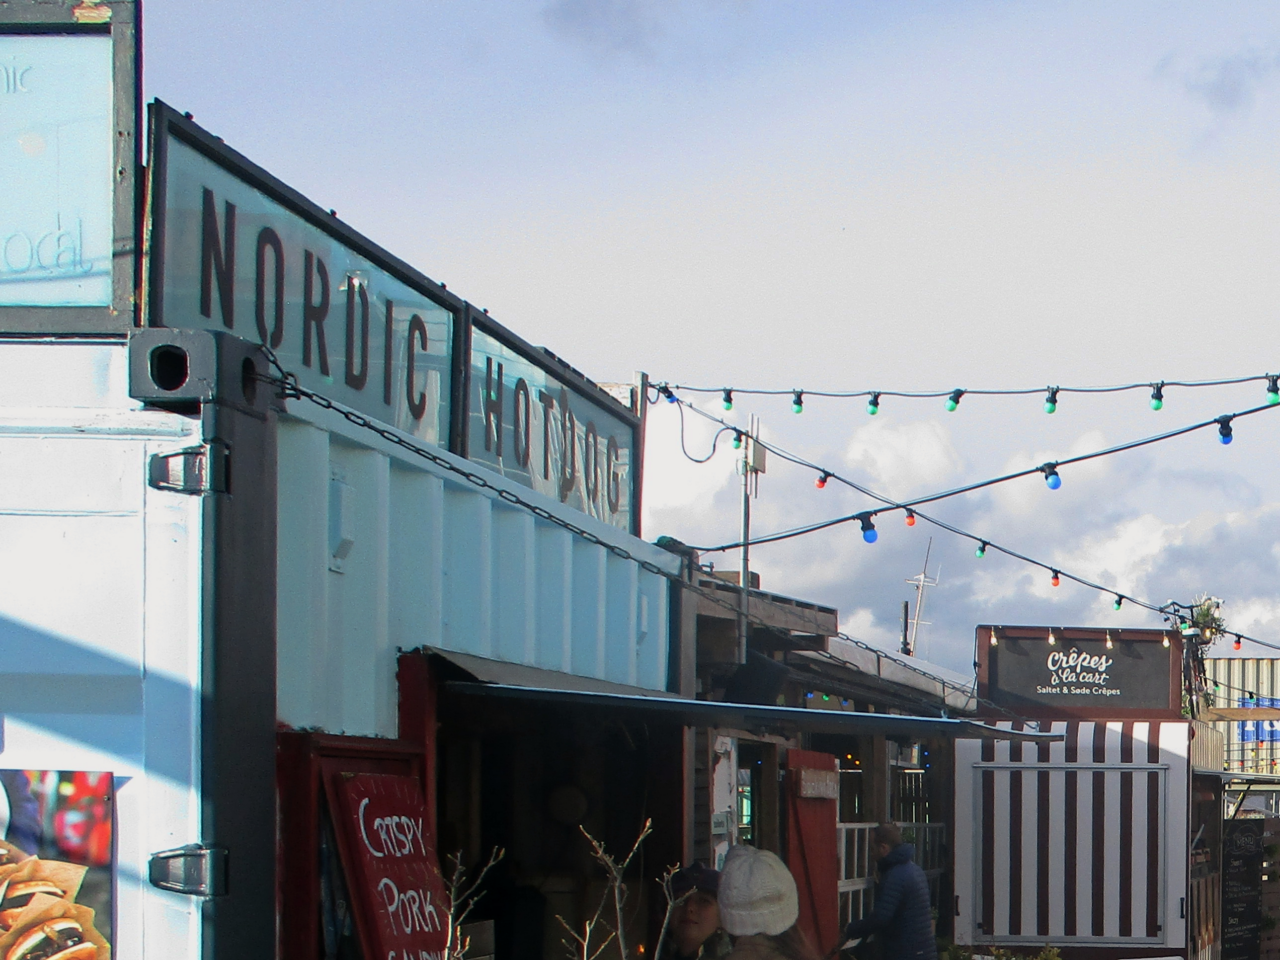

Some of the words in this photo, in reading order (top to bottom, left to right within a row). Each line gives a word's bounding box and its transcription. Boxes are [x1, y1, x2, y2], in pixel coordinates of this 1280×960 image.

[0, 211, 93, 274] ocal
[200, 185, 428, 420] NORDIC
[1047, 647, 1113, 673] Crêpes
[1059, 668, 1077, 682] la
[1079, 672, 1109, 685] cart
[1037, 686, 1060, 694] Saltet
[1062, 686, 1069, 694] &
[1070, 686, 1091, 695] Søde
[1092, 686, 1121, 696] Crêpes
[359, 797, 427, 857] CRISPY
[378, 877, 441, 936] PORK
